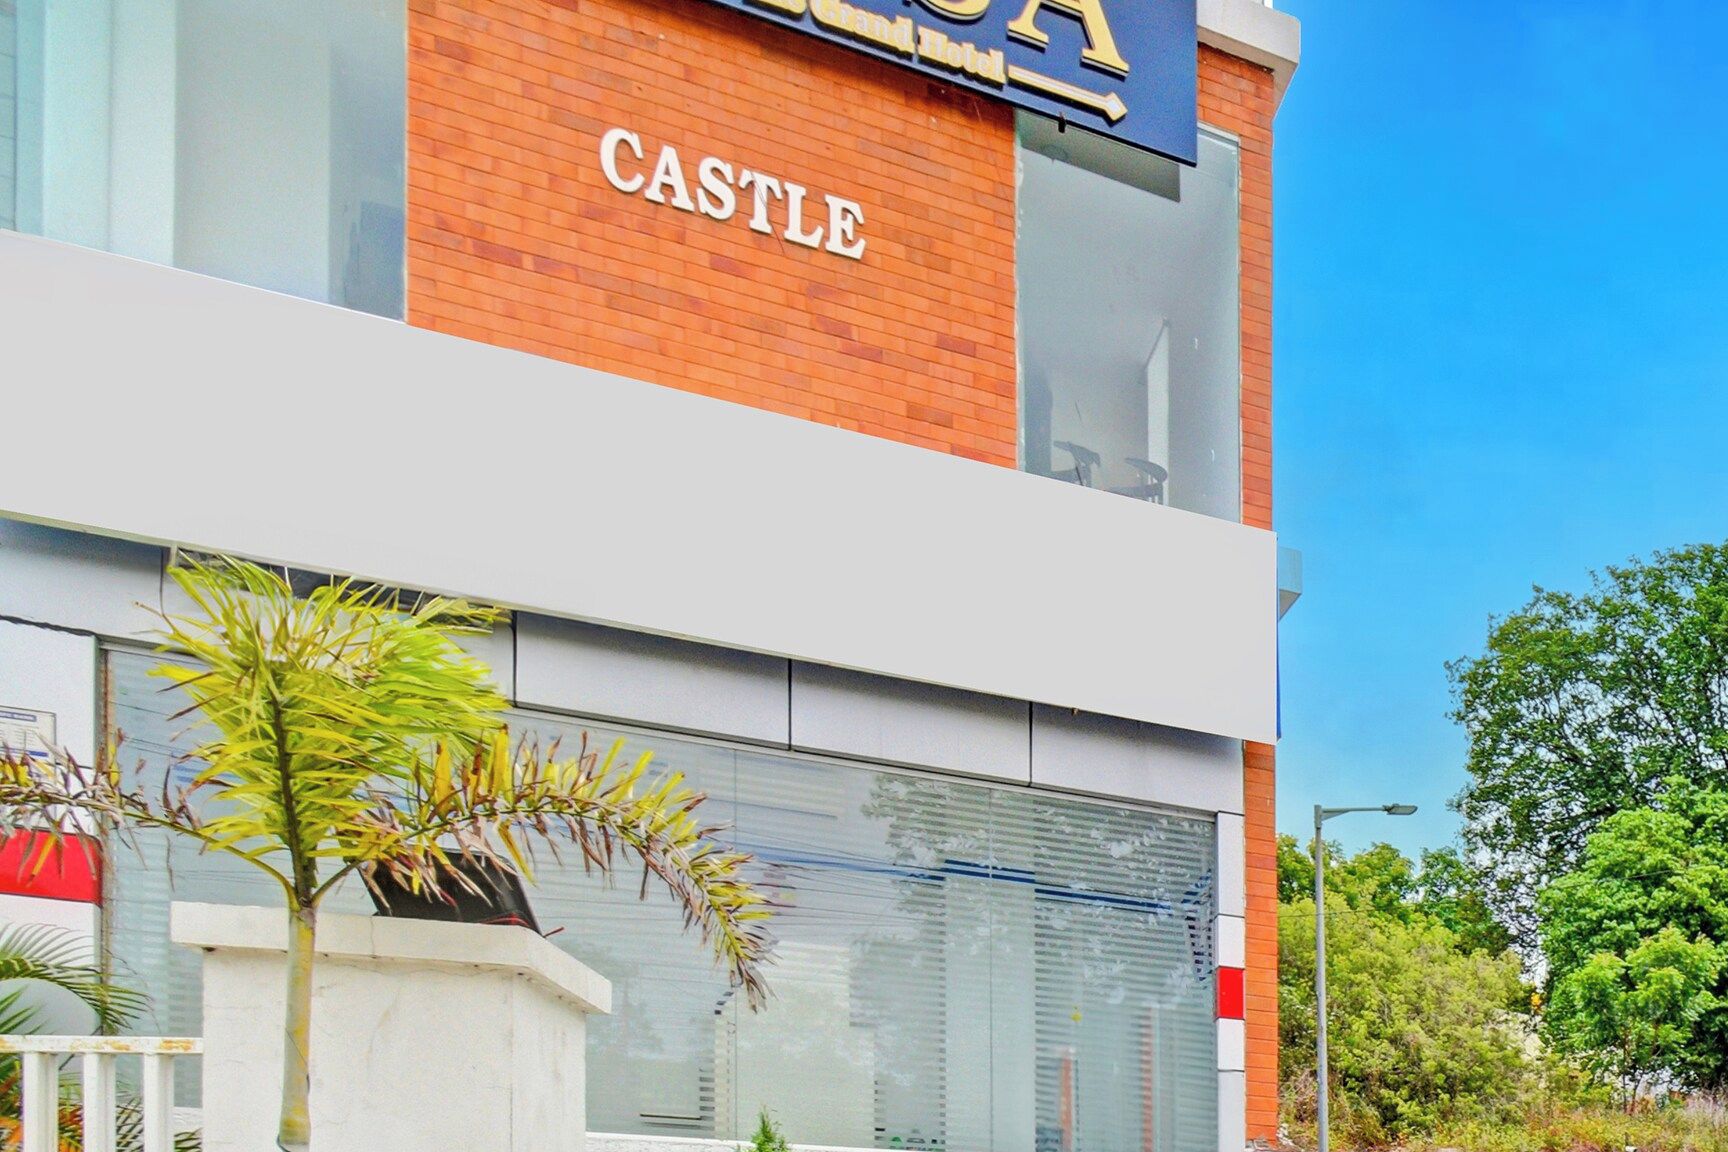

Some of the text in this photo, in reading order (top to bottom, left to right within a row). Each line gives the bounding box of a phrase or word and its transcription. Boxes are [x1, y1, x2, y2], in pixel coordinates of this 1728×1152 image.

[809, 0, 1005, 83] Grand Hotel
[599, 127, 866, 260] CASTLE
